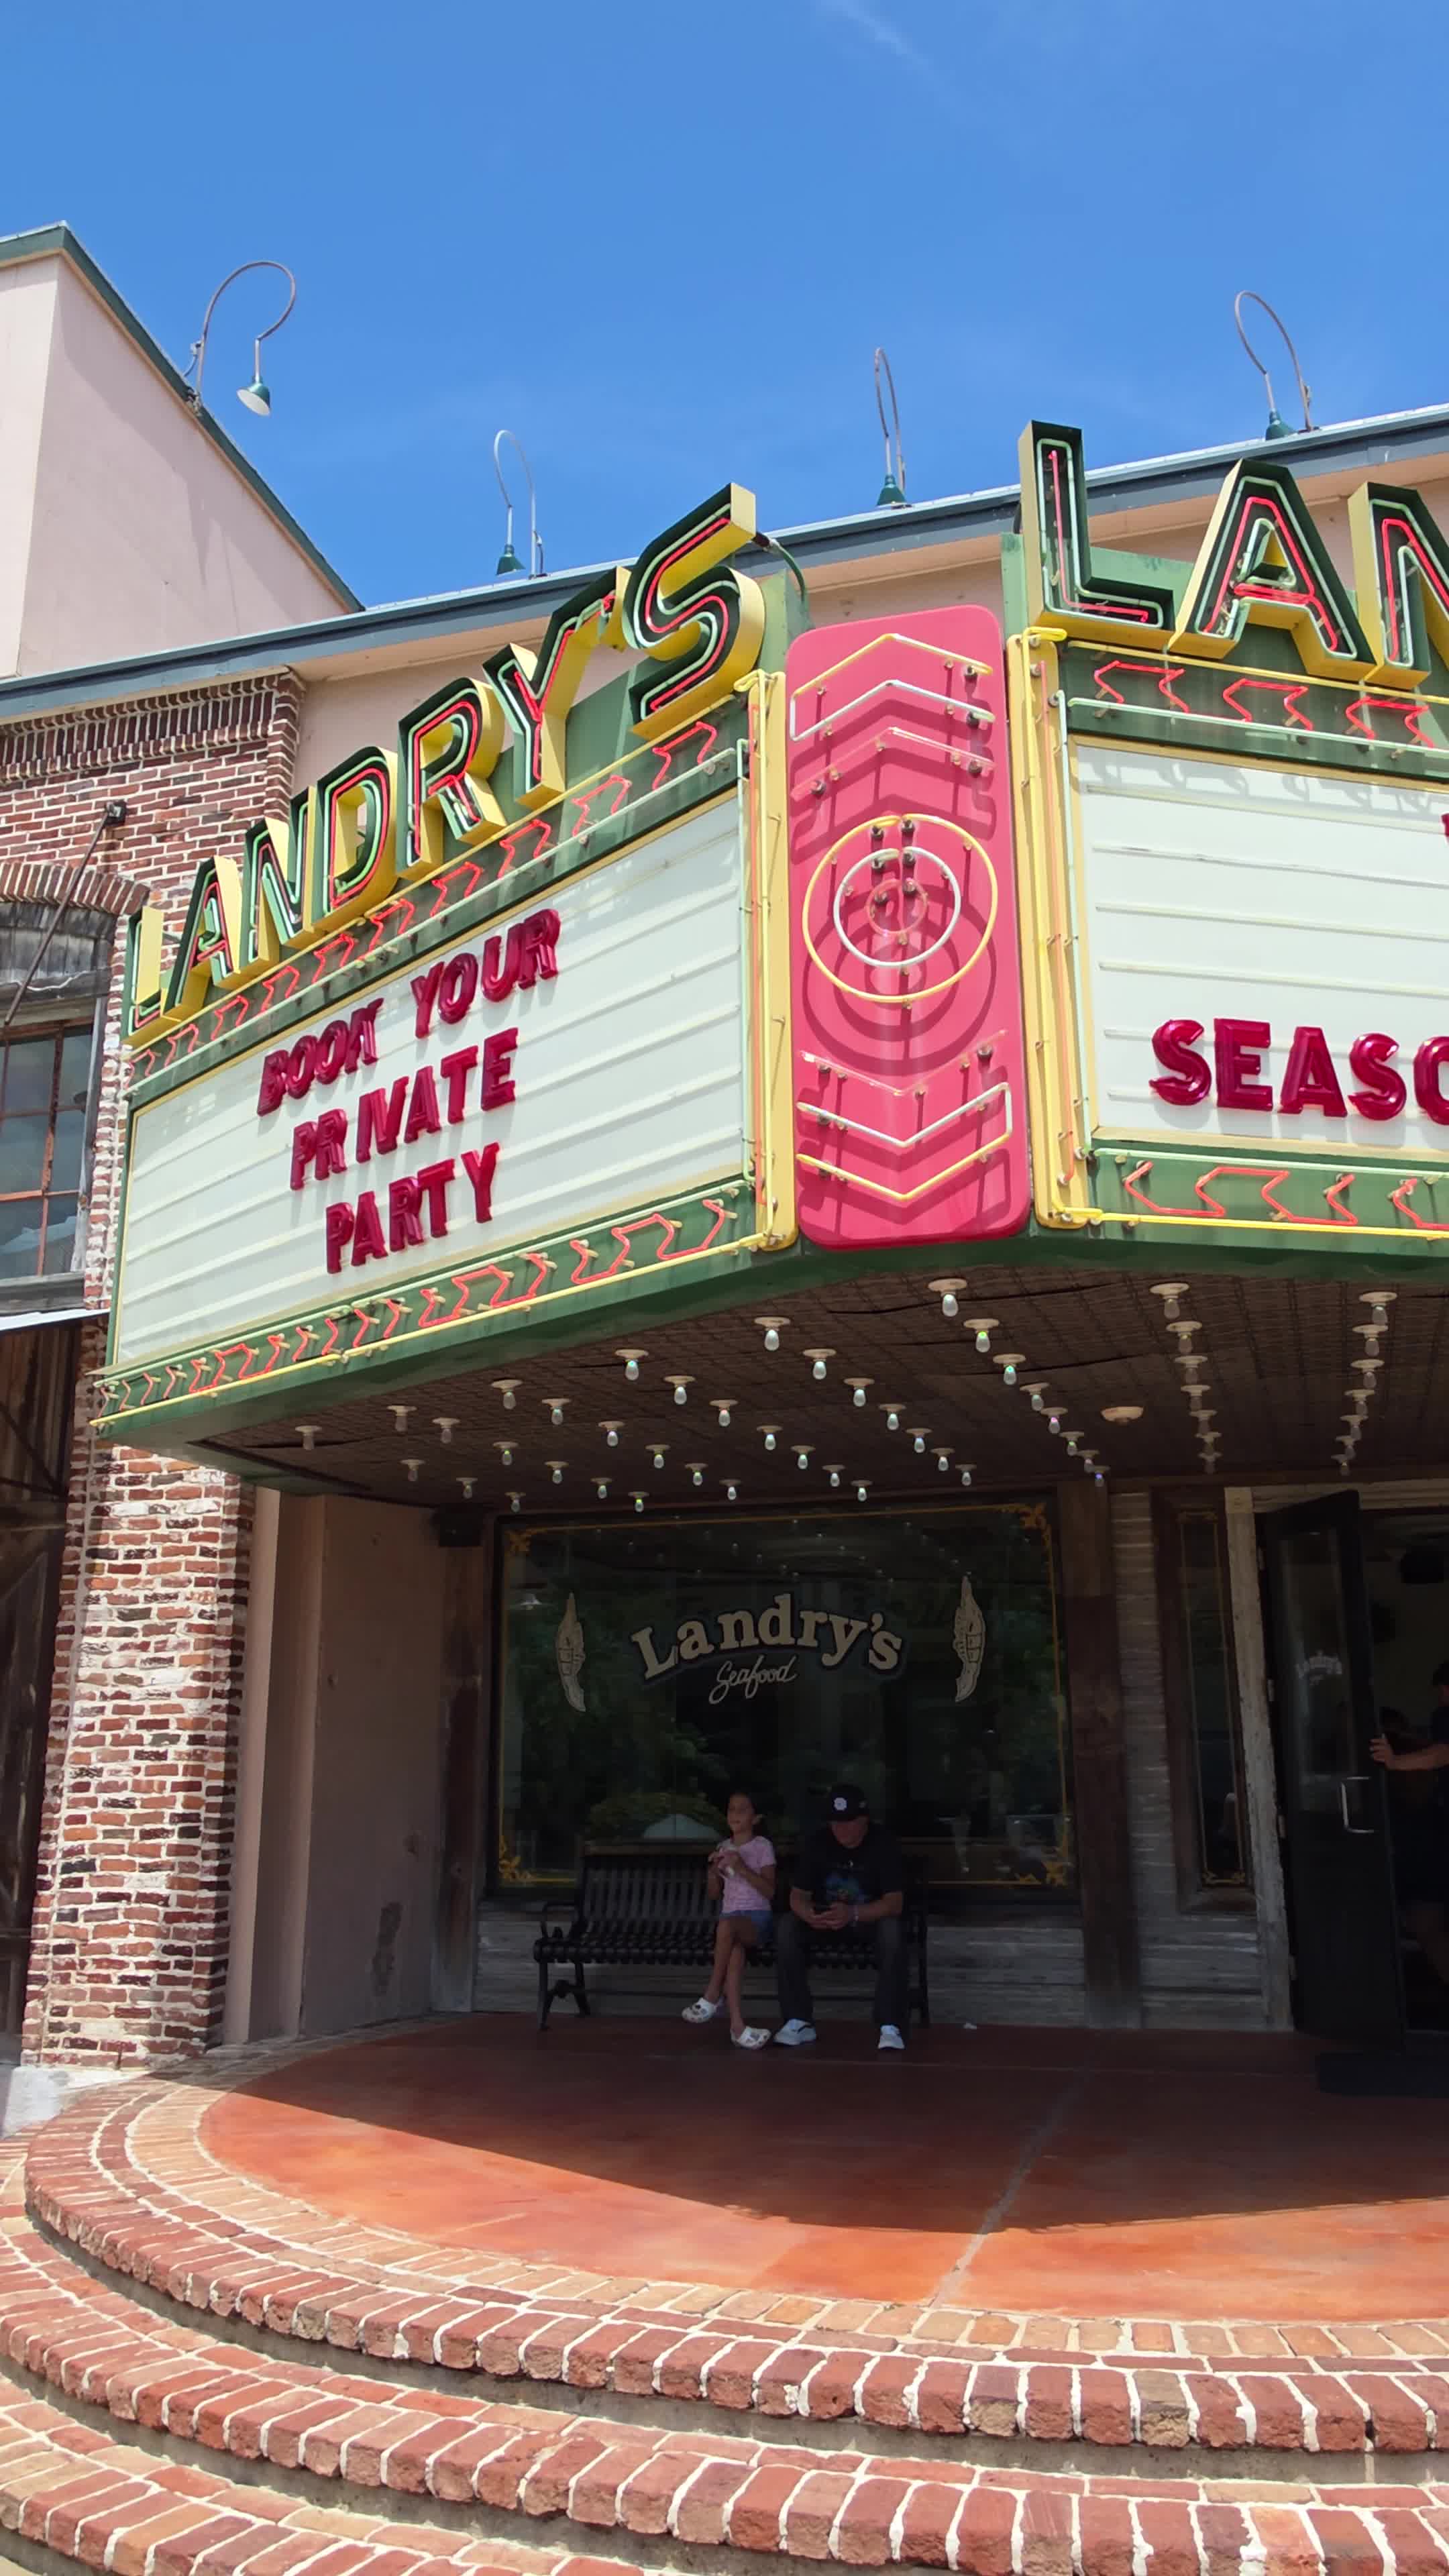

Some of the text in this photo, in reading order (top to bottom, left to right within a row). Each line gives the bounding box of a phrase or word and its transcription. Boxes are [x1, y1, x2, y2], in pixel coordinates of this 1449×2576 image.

[257, 908, 561, 1116] BOOK YOUR
[290, 1027, 519, 1190] PRIVATE
[325, 1142, 500, 1274] PARTY
[631, 1593, 902, 1679] Landry's
[708, 1654, 798, 1704] Seafood
